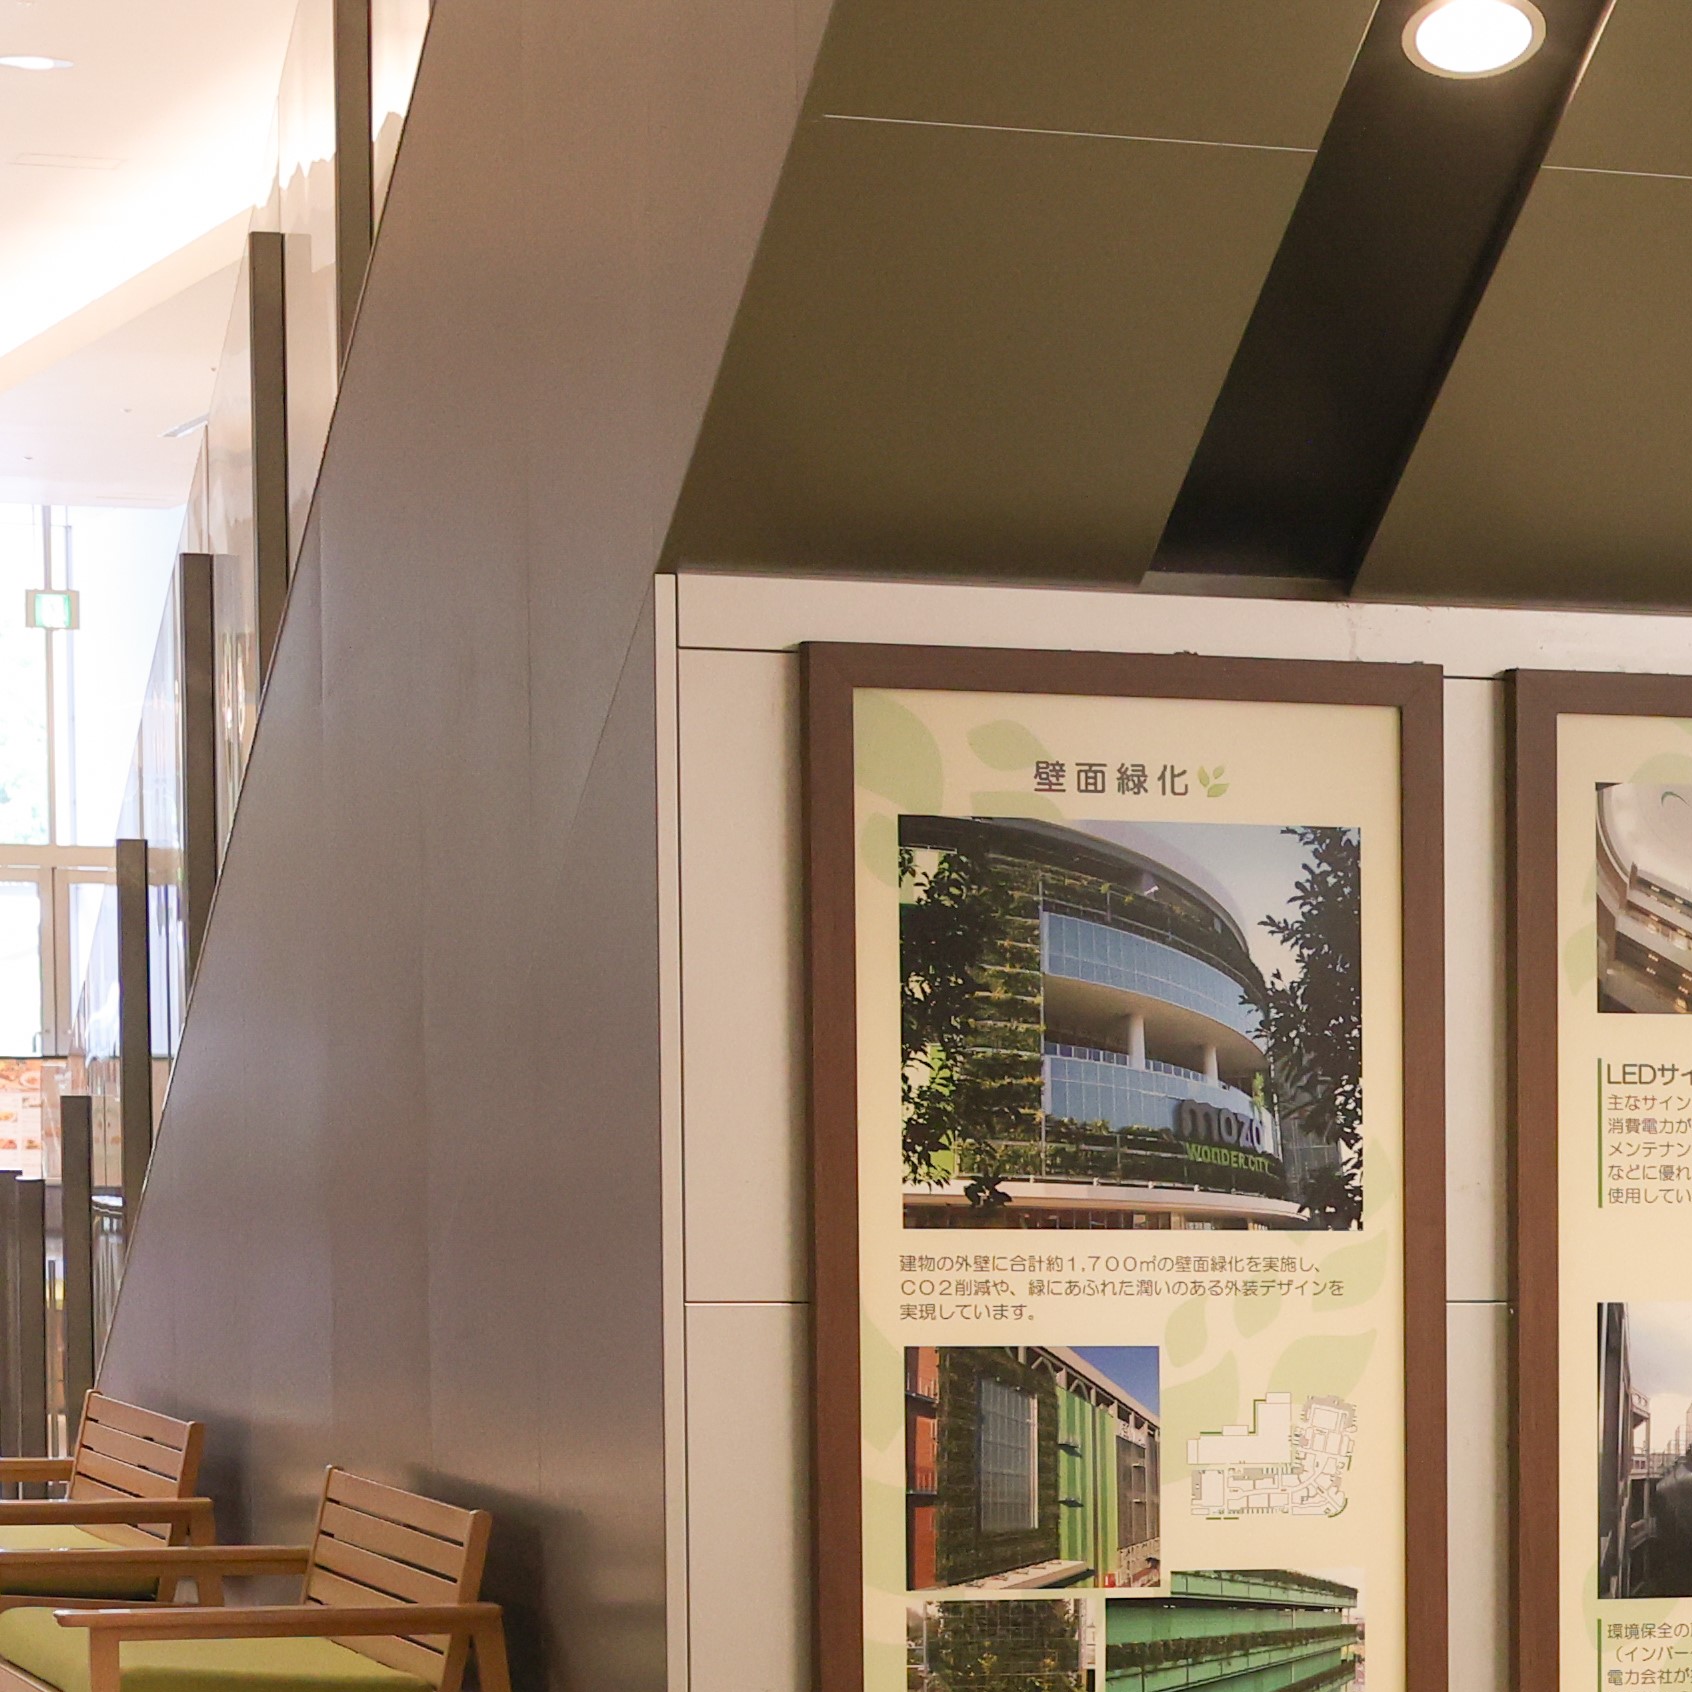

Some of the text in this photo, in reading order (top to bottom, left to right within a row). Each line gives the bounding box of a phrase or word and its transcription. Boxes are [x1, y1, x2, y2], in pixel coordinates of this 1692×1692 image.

[1033, 760, 1190, 797] 壁面緑化
[899, 1303, 1037, 1322] 実現しています。
